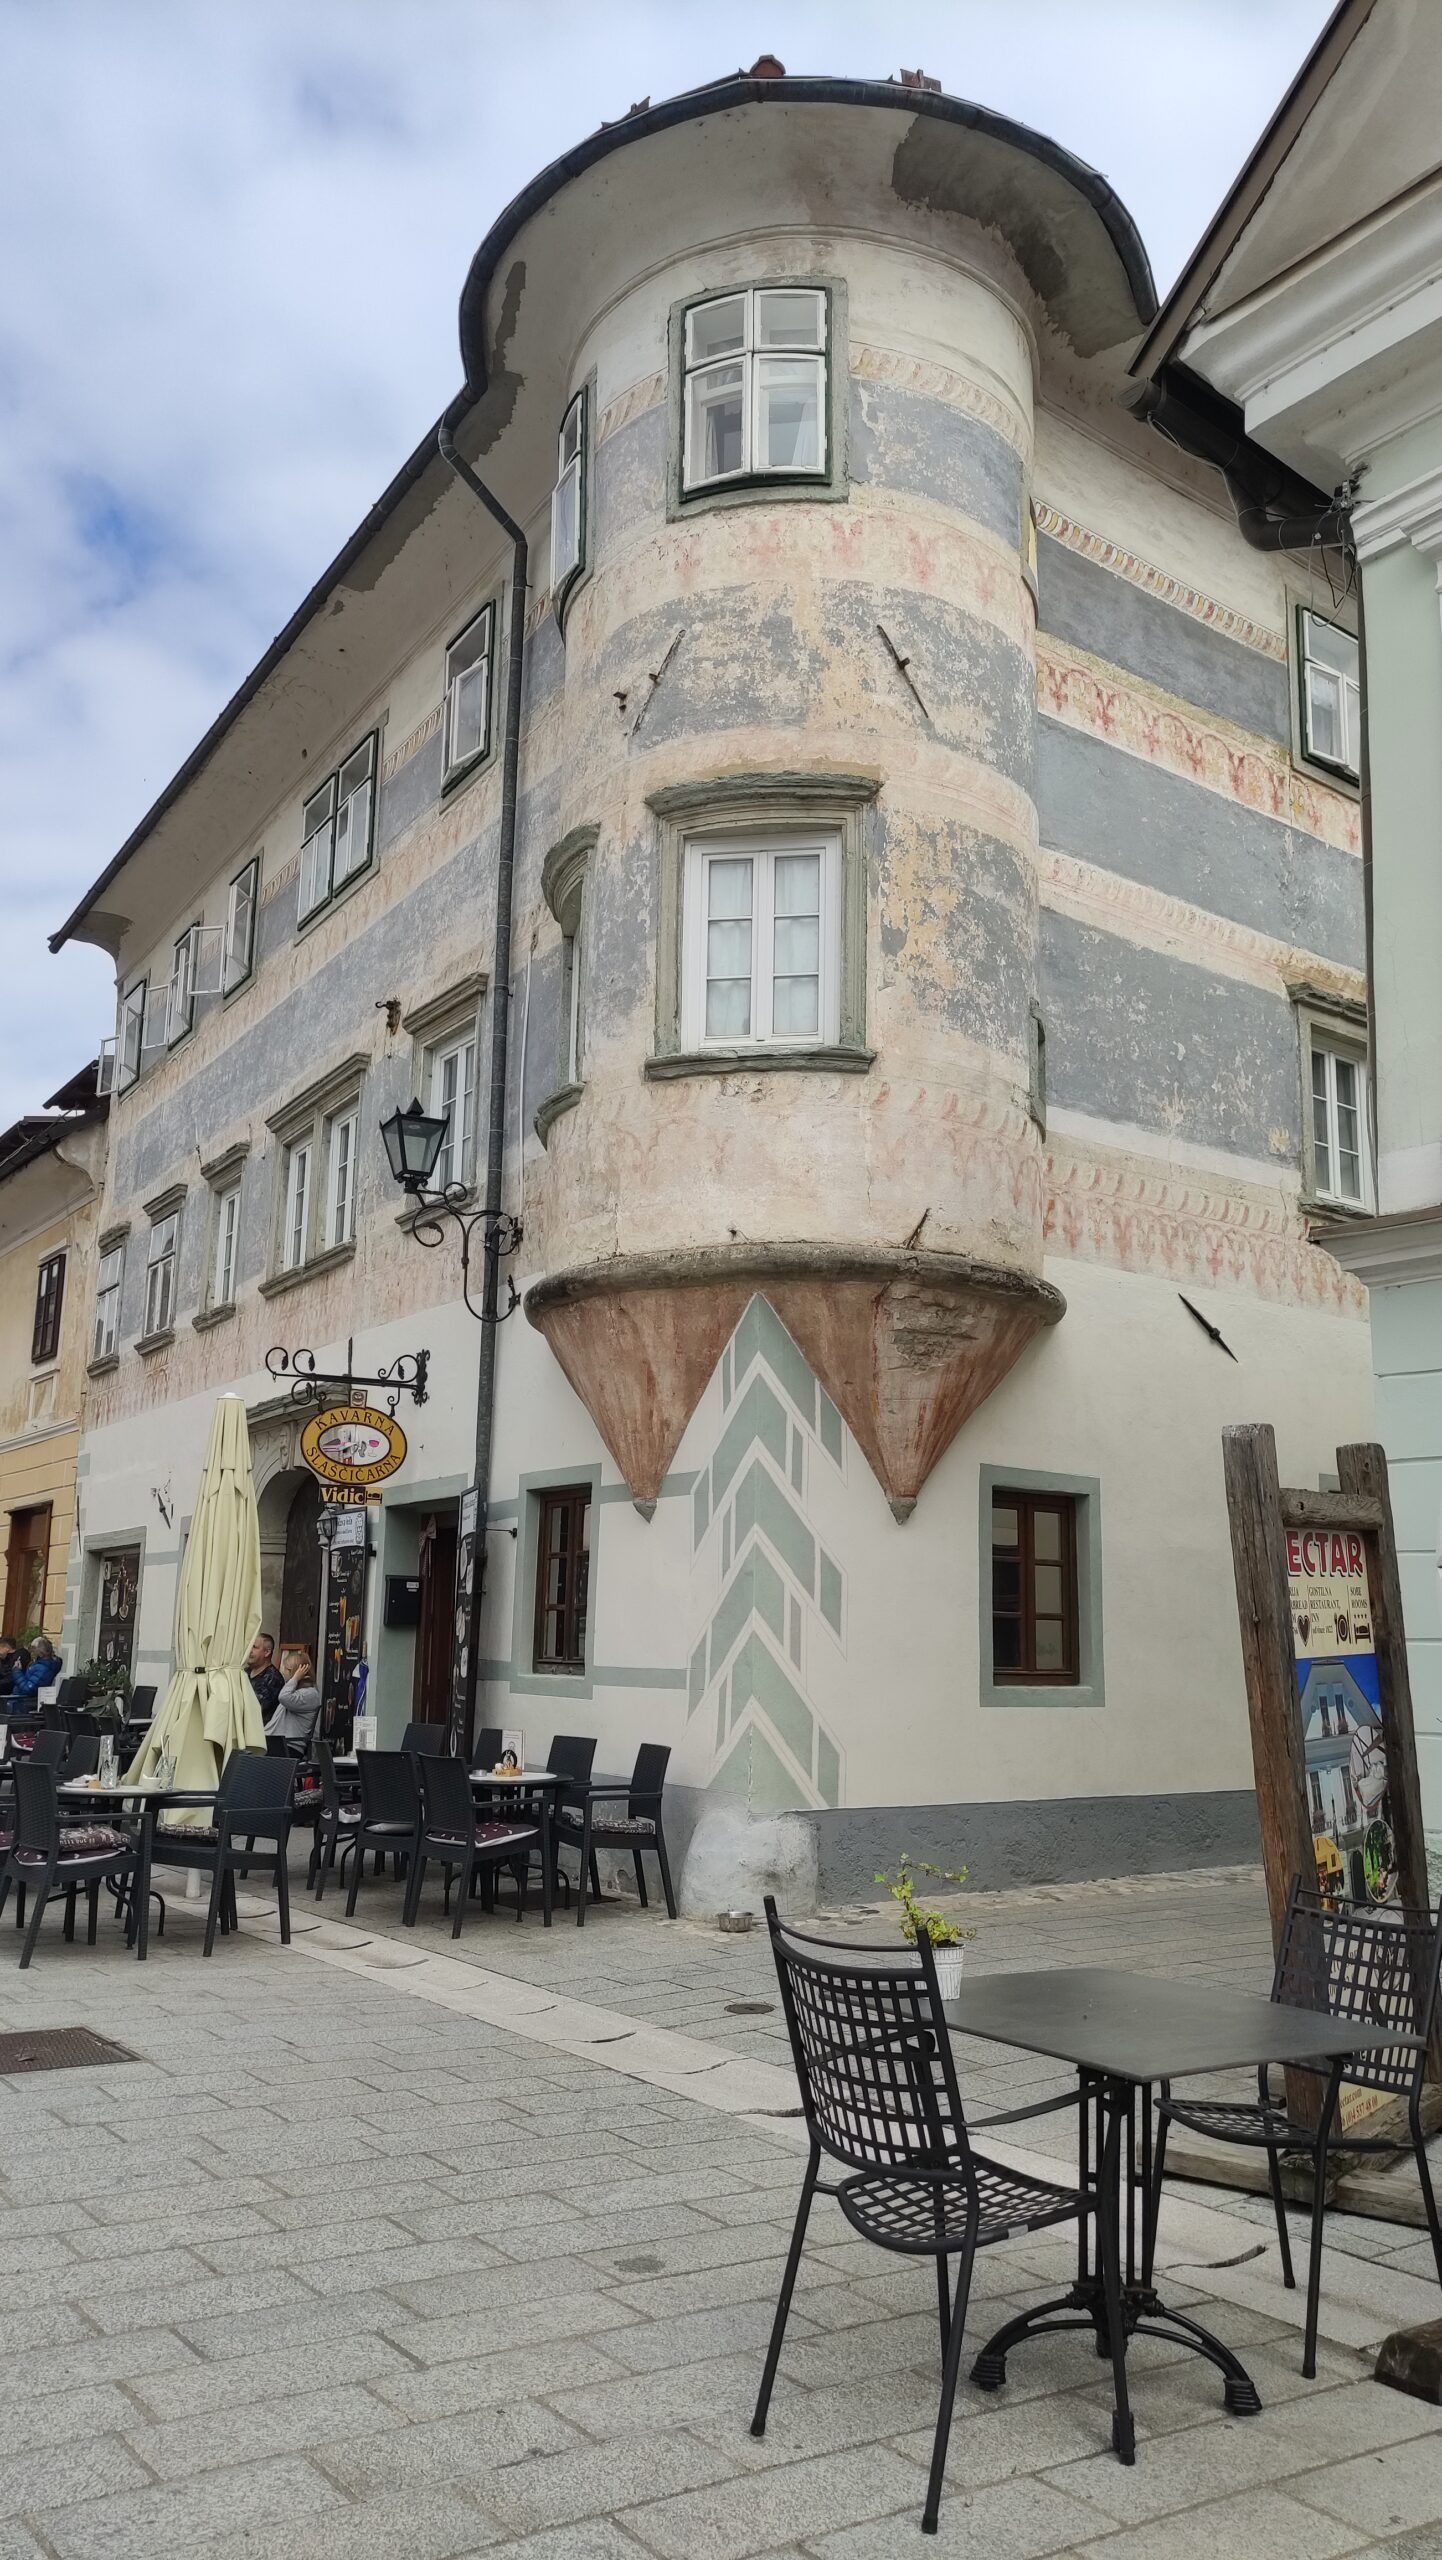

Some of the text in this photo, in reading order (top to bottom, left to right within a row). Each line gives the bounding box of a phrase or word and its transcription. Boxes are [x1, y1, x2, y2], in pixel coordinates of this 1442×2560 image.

[314, 1409, 395, 1436] KAVARNA
[306, 1446, 401, 1481] SLAŠČIČARNA
[320, 1486, 365, 1504] Vidic
[1309, 1586, 1332, 1597] GOSTILNA
[1351, 1599, 1367, 1609] ROOMS
